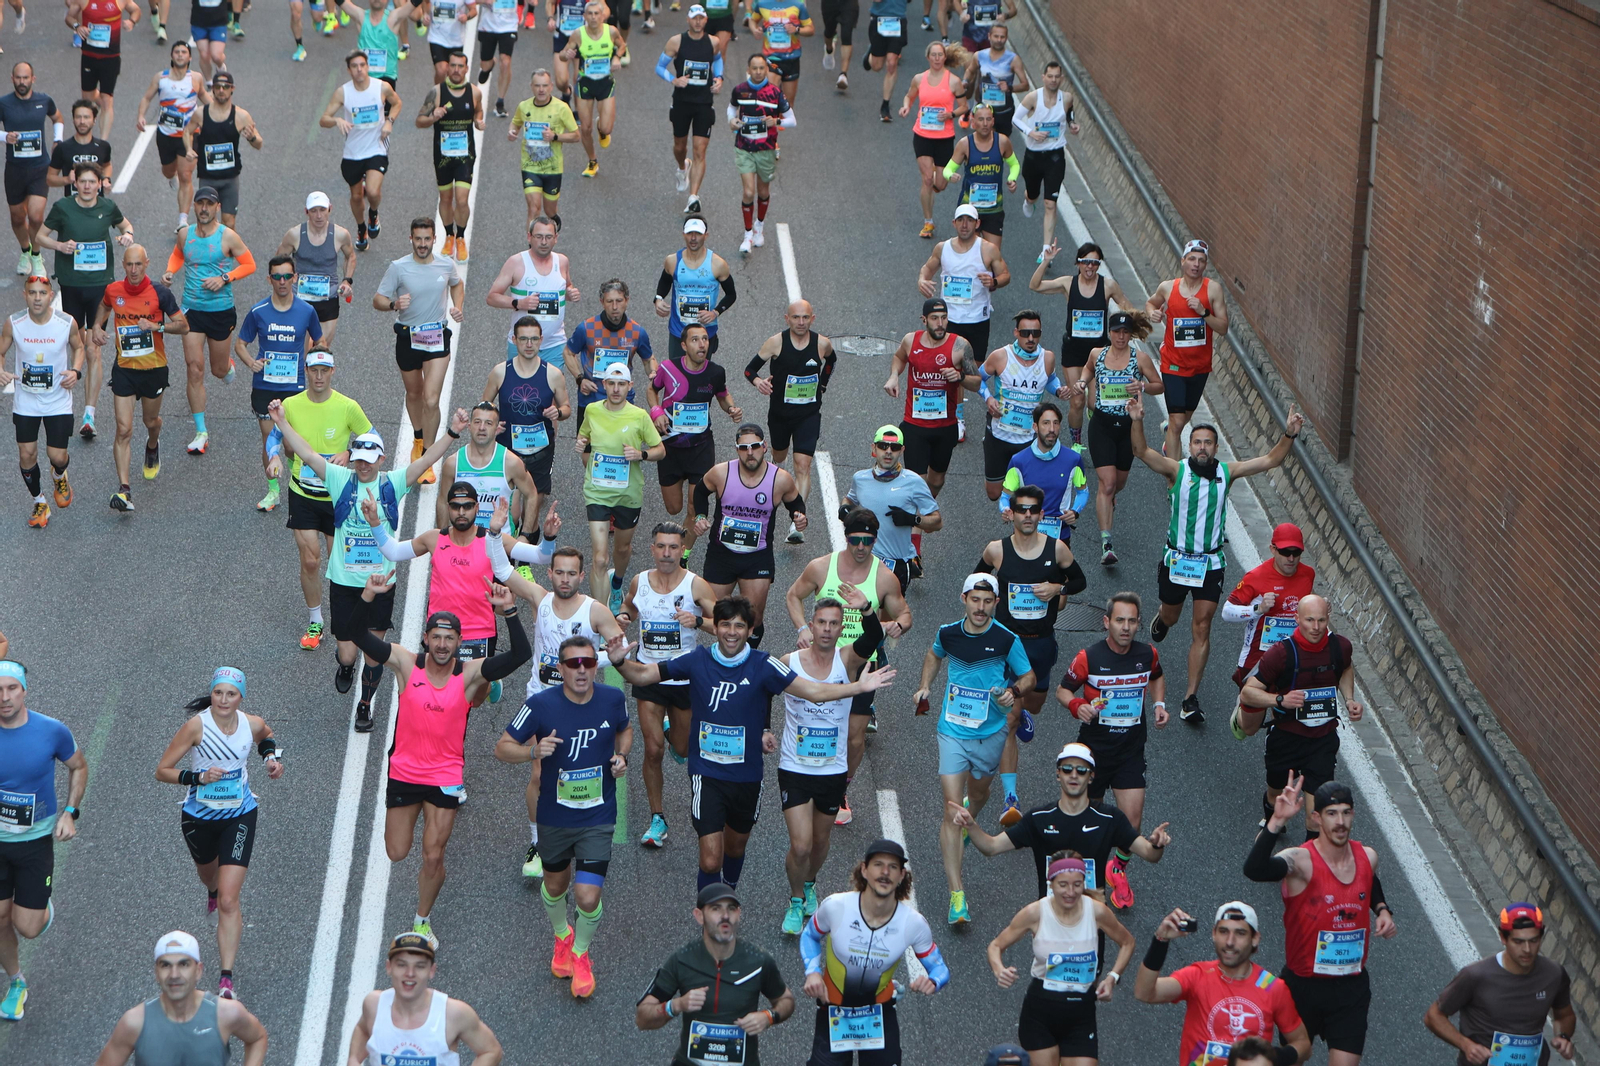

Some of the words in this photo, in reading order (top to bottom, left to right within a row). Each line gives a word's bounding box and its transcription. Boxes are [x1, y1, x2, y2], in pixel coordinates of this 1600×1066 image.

[970, 164, 1000, 172] UBUNTU
[268, 324, 296, 333] ¡Vamos,
[278, 334, 295, 342] Cris!
[1013, 379, 1038, 389] LAR
[1008, 392, 1038, 401] RUNNING
[725, 506, 768, 515] RUNNERS
[960, 690, 984, 698] ZURICH
[712, 748, 732, 756] CARLITO
[221, 772, 238, 780] URICH
[3, 795, 28, 803] ZURICH
[2, 807, 16, 816] 3112
[232, 824, 248, 860] 2XU
[848, 955, 884, 969] ANTONIO
[847, 1008, 875, 1017] ZURICH
[710, 1027, 739, 1036] ZURICH
[409, 1042, 426, 1056] AMERIC
[708, 1043, 726, 1052] 3208
[704, 1053, 728, 1062] NAVITAS
